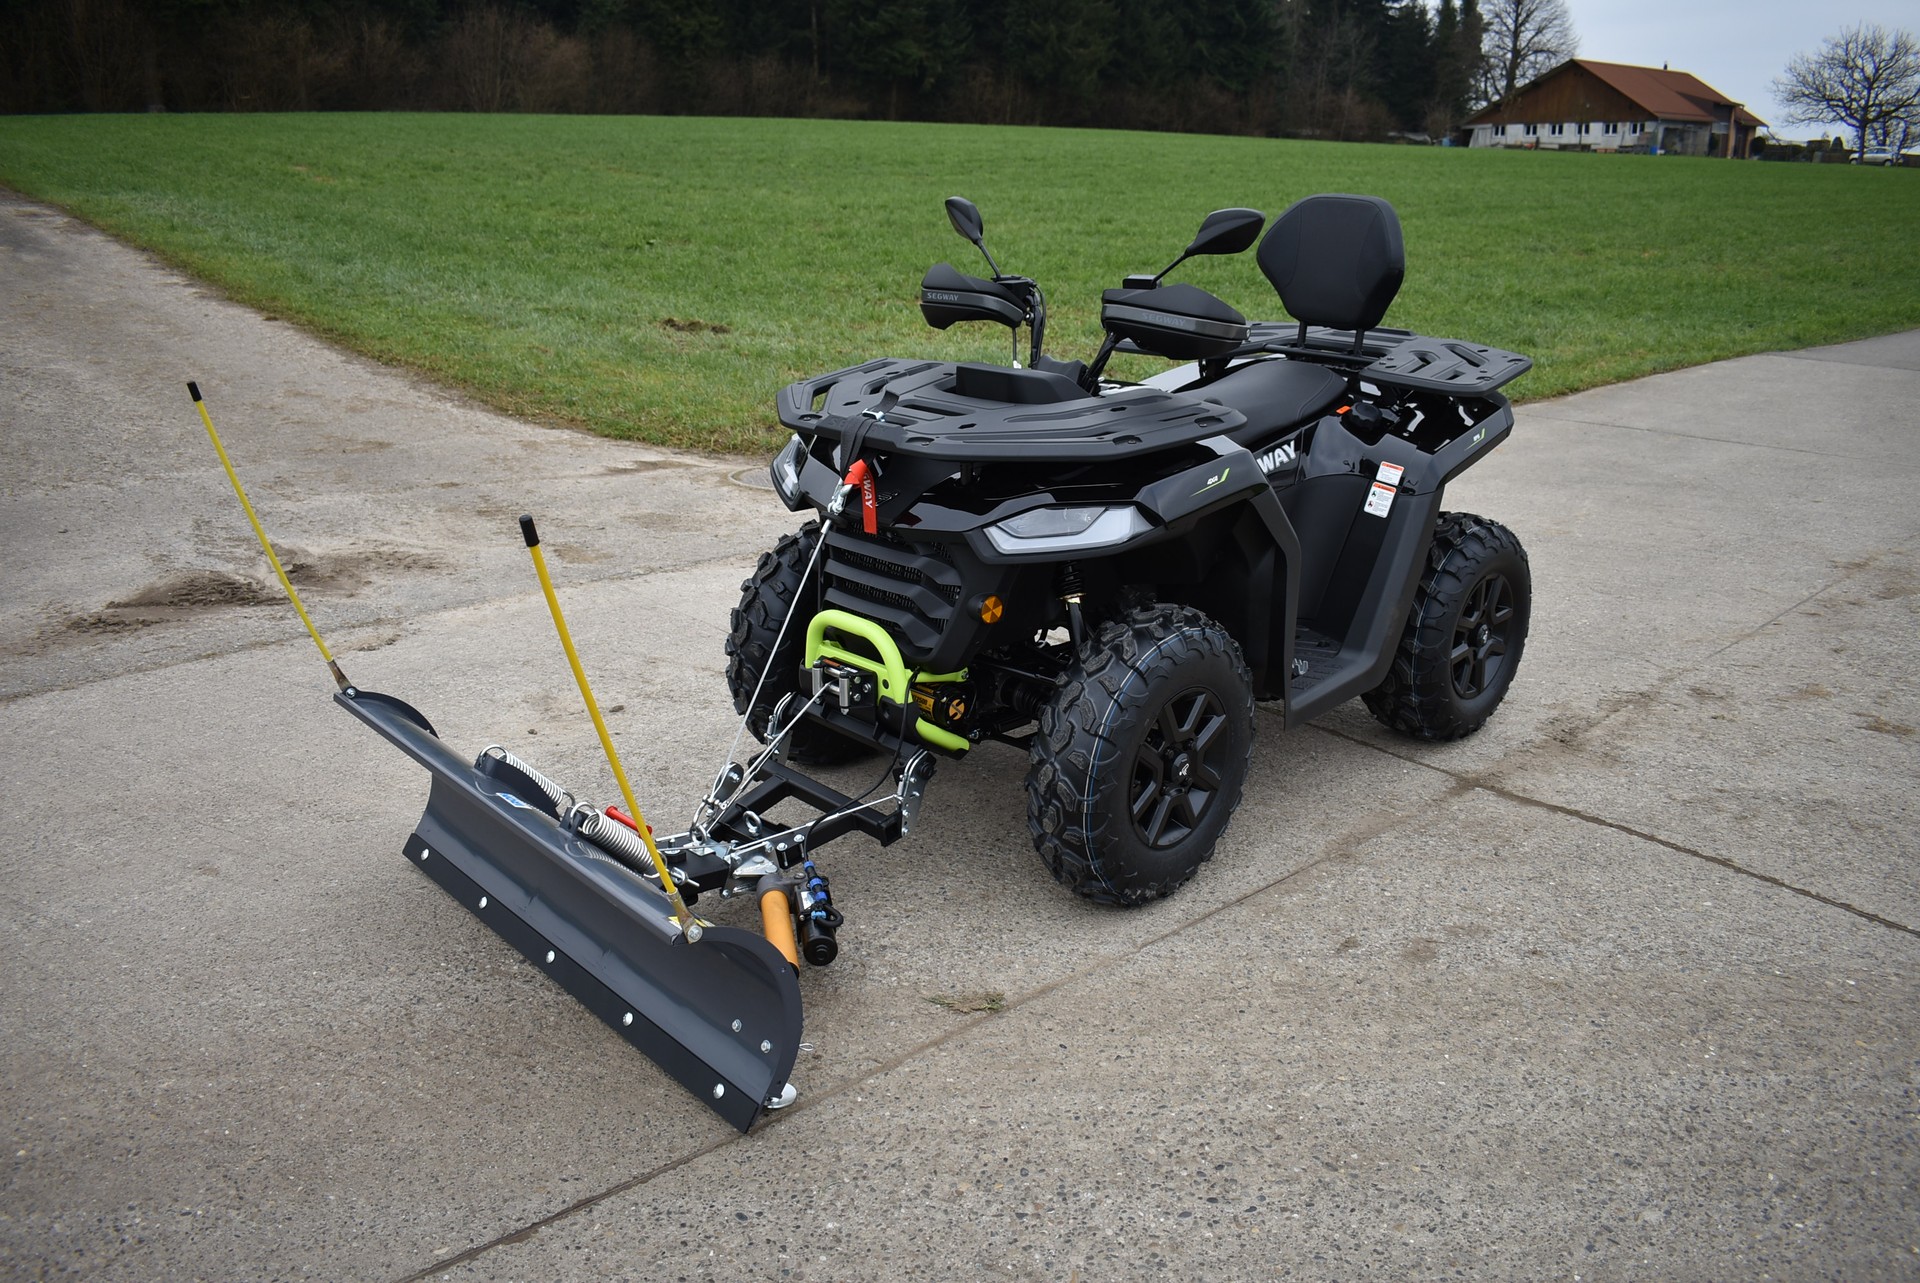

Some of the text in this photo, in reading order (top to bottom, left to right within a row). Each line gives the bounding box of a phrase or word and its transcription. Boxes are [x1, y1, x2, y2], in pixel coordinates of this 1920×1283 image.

[927, 292, 959, 302] SEGWAY
[1141, 312, 1186, 327] SEGWAY
[1256, 439, 1297, 475] WAY
